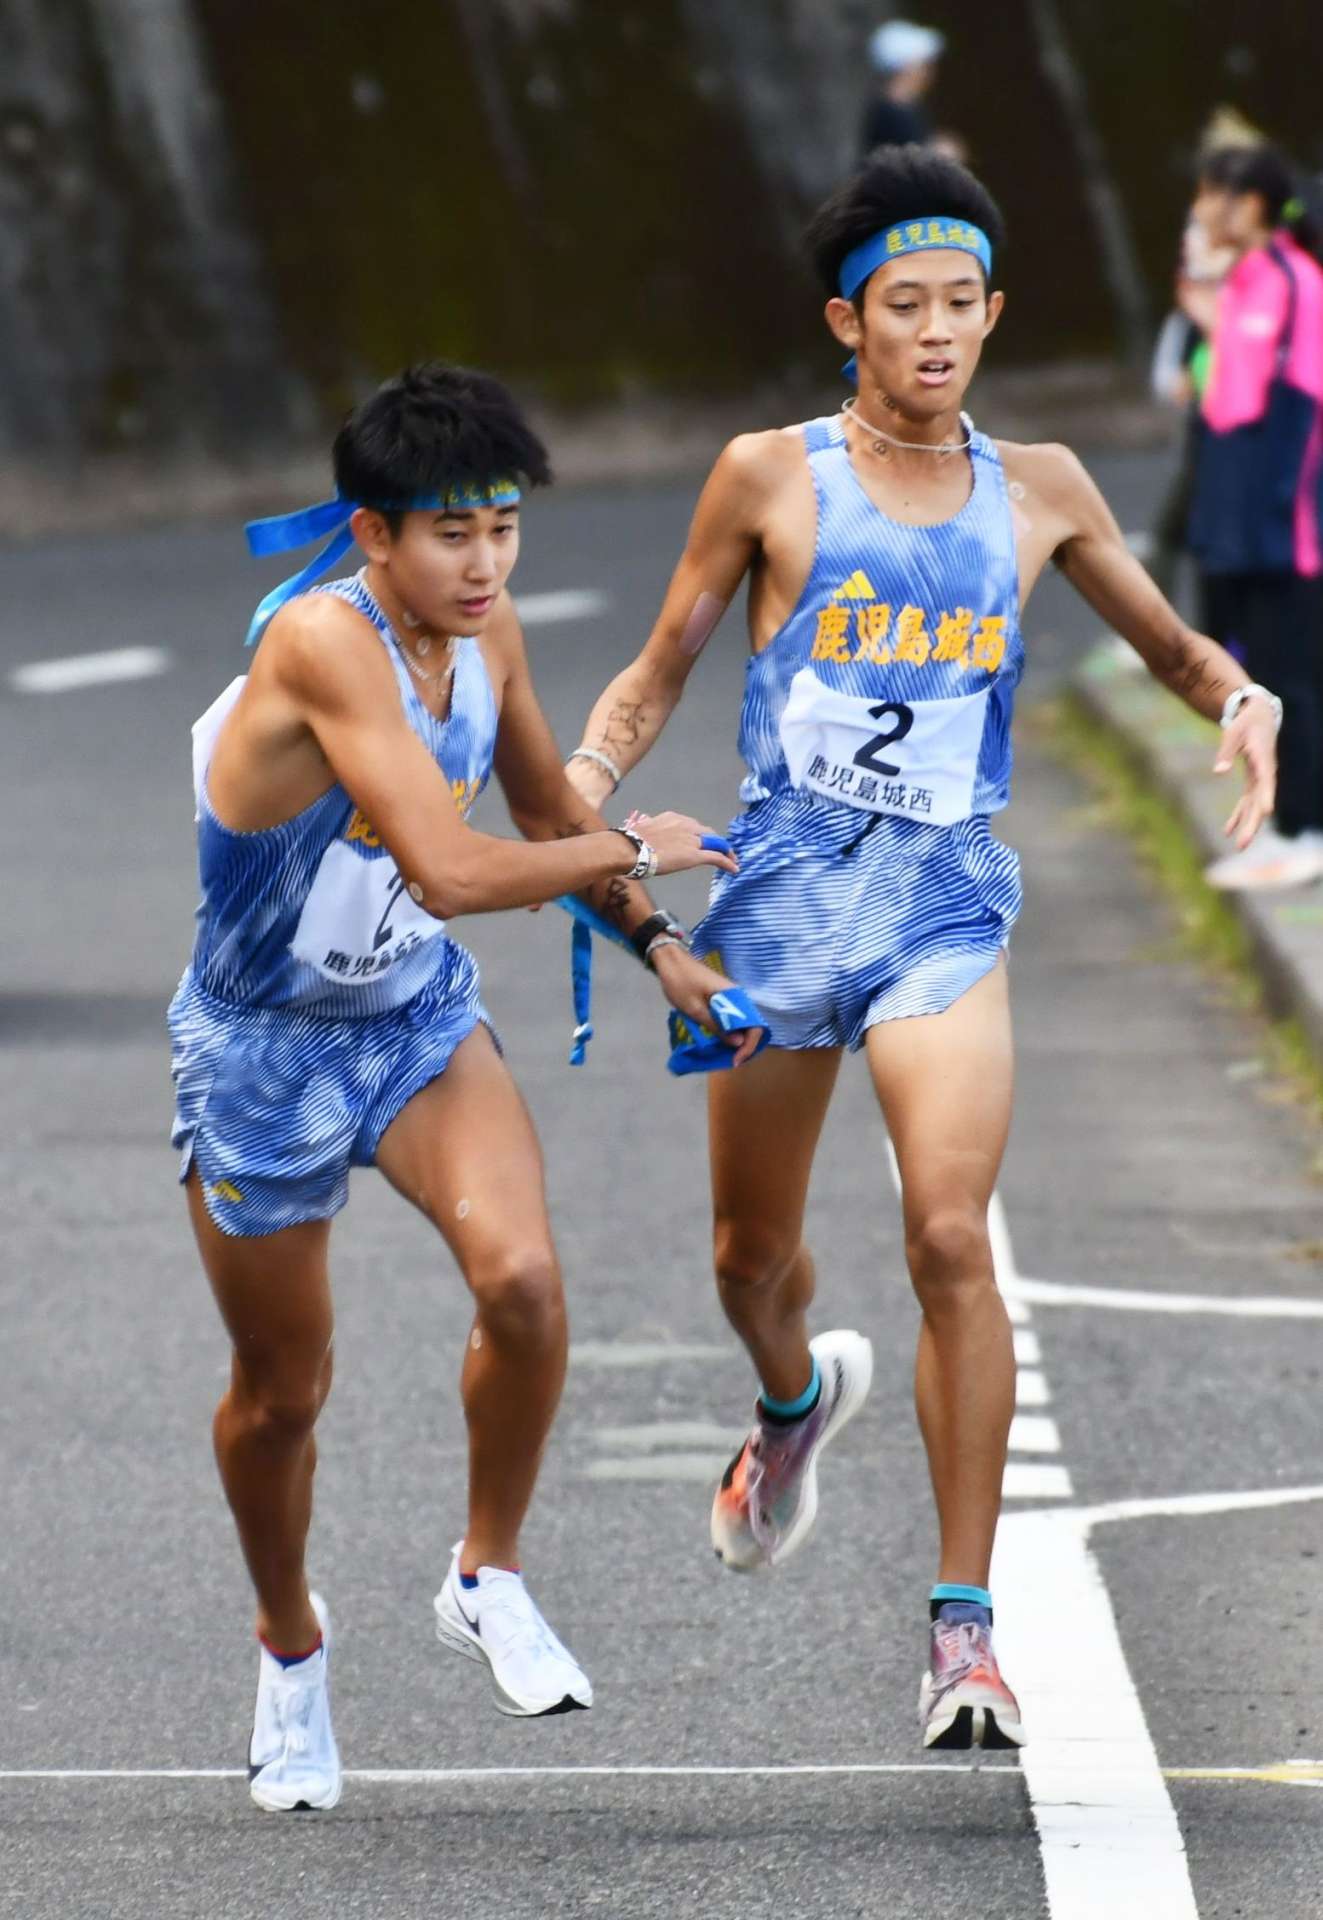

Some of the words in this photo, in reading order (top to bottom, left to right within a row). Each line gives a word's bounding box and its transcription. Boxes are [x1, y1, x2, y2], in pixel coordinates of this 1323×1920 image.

[811, 602, 1007, 673] 鹿児島城西
[852, 701, 915, 777] 2
[807, 754, 935, 813] 鹿児島城西
